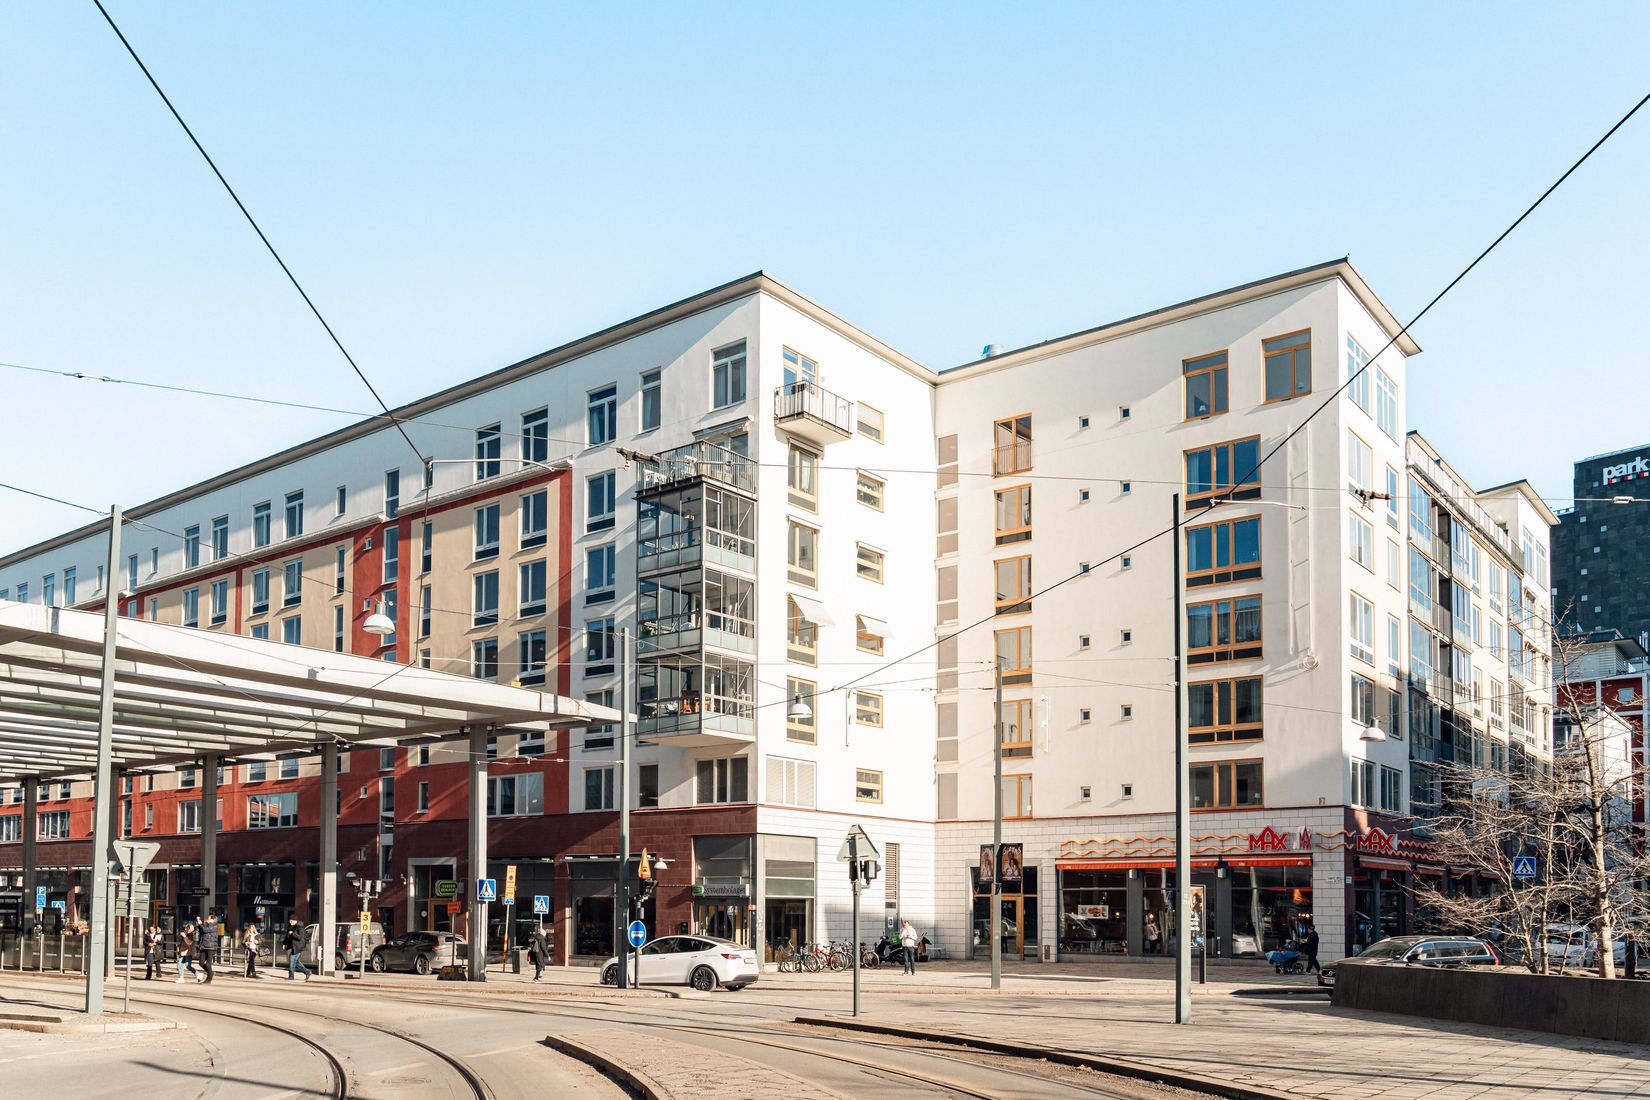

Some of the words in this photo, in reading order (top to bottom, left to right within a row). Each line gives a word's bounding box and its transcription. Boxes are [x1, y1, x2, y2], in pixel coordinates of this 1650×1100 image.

[1603, 456, 1649, 485] park
[1249, 825, 1288, 851] MAX
[1356, 827, 1395, 850] MAX
